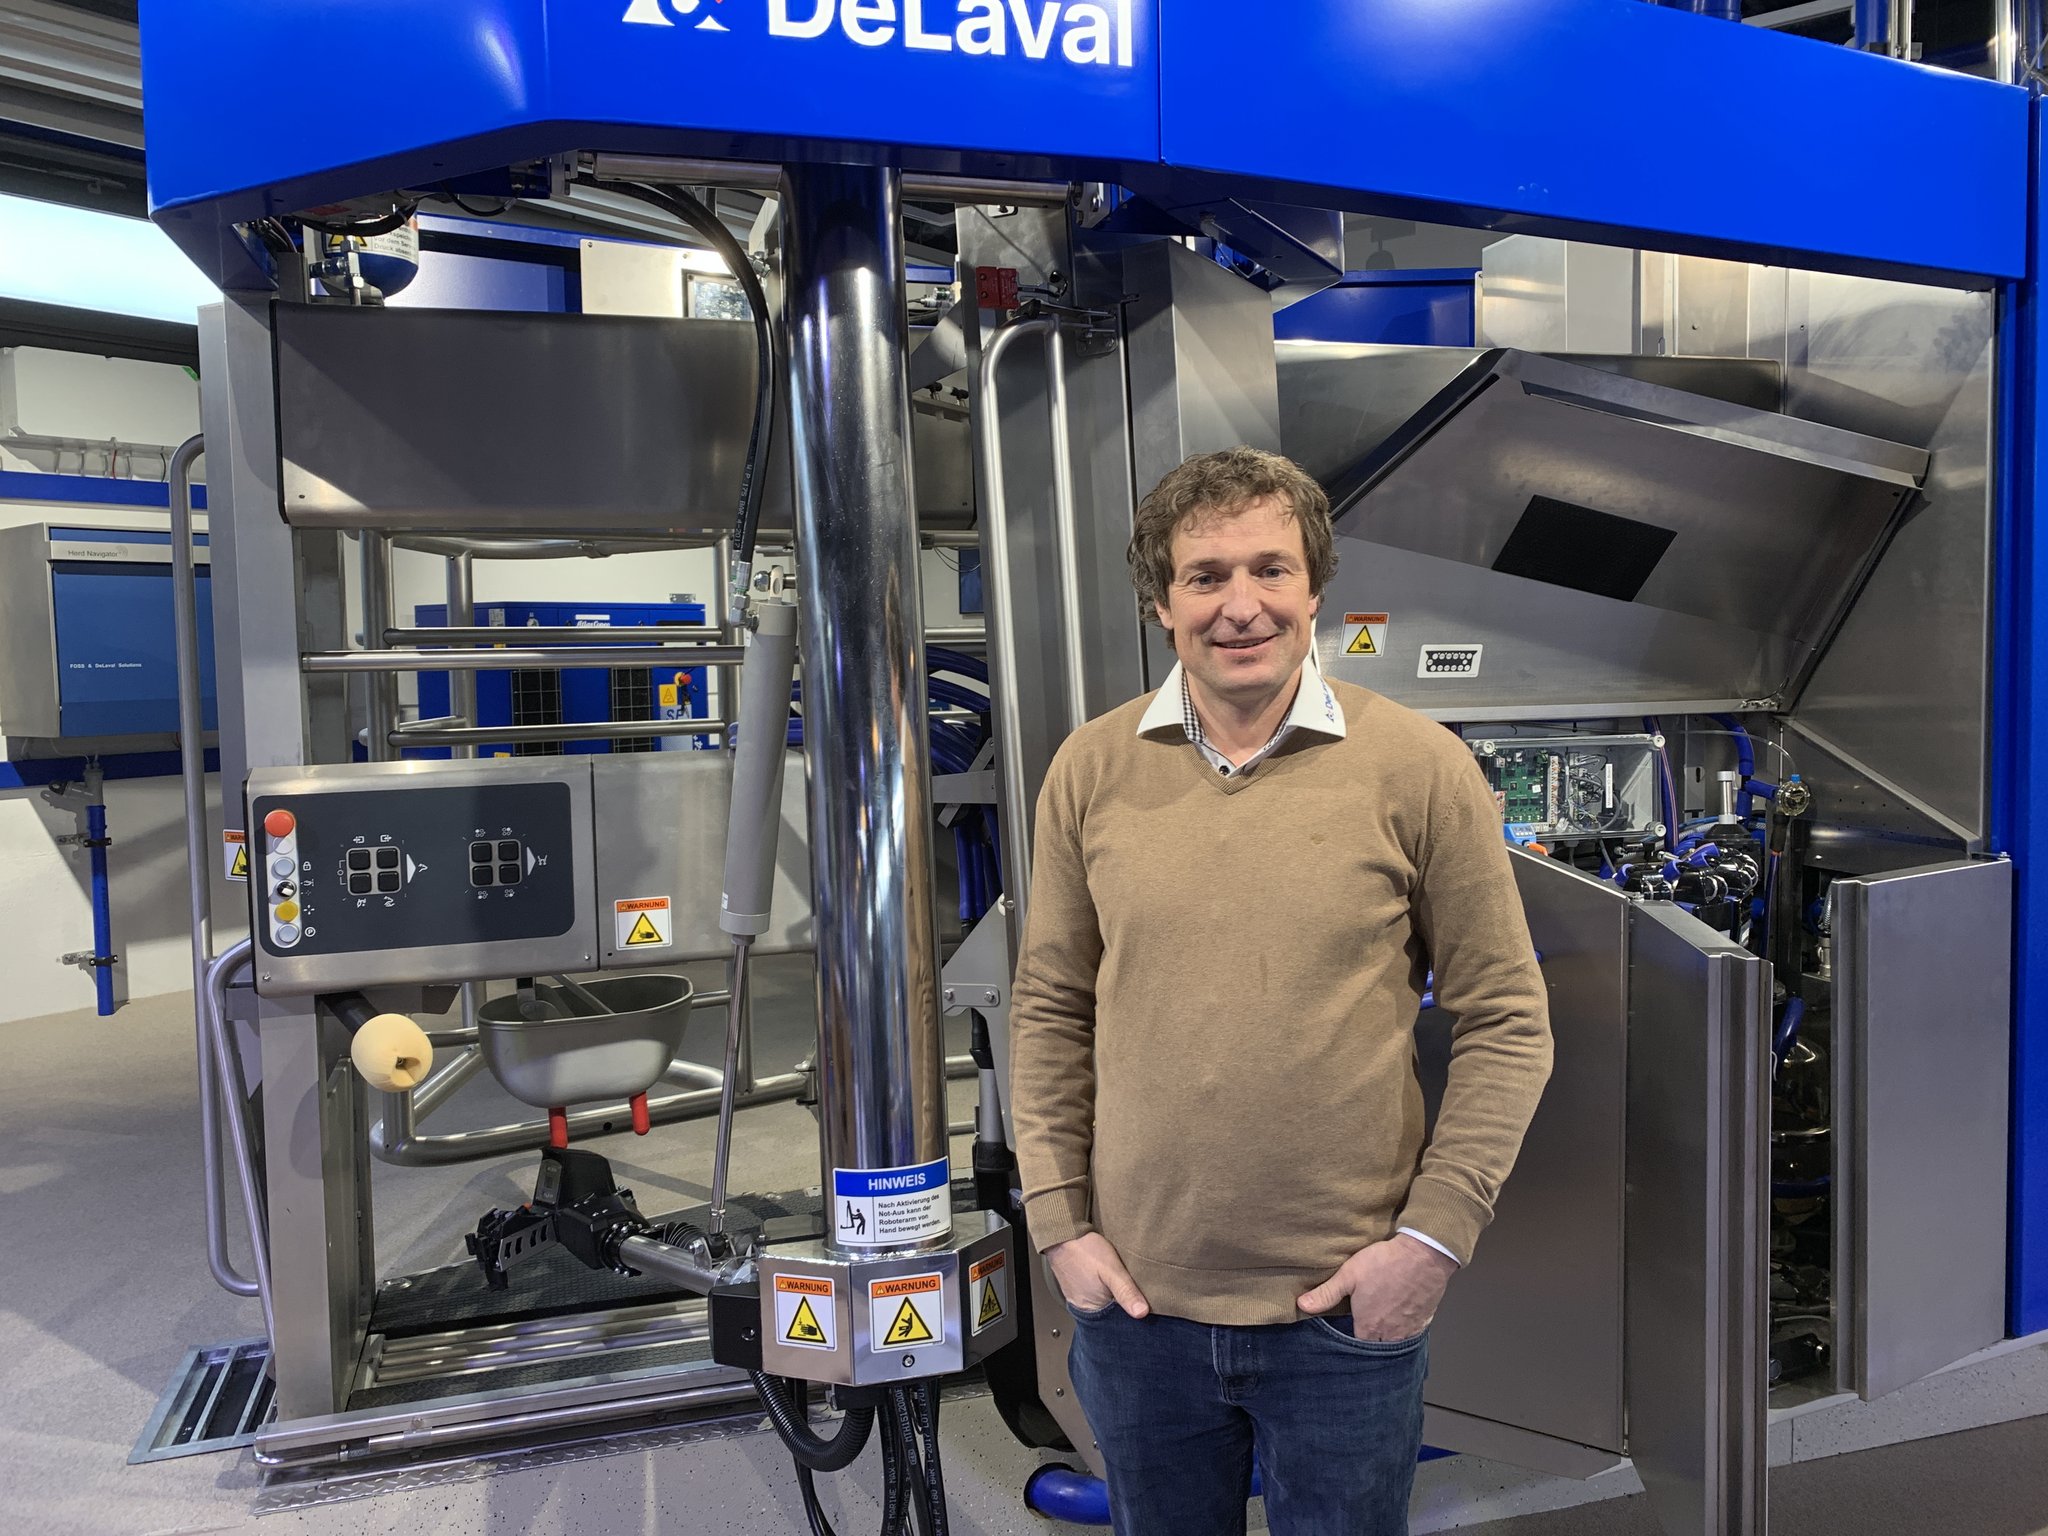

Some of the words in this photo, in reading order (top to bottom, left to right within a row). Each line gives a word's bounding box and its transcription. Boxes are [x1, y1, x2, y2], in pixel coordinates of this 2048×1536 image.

[768, 0, 1133, 67] DeLaval
[737, 500, 746, 516] BAR
[68, 549, 86, 557] Herd
[86, 550, 118, 558] Navigator
[1353, 615, 1385, 623] WARNUNG
[627, 899, 666, 910] WARNUNG
[868, 1172, 926, 1191] HINWEIS
[896, 1196, 931, 1207] Aktivierung
[931, 1193, 940, 1201] des
[906, 1207, 921, 1215] kann
[922, 1204, 932, 1212] der
[879, 1216, 917, 1225] Roboterarm
[879, 1225, 897, 1234] Hand
[898, 1223, 921, 1233] bewegt
[978, 1256, 1004, 1276] WARNUNG
[786, 1280, 829, 1293] WARNUNG
[886, 1278, 936, 1294] WARNUNG
[920, 1413, 929, 1428] LOT
[888, 1467, 896, 1484] MAX
[929, 1468, 937, 1485] BAR
[888, 1488, 897, 1519] MARINE
[930, 1490, 940, 1504] 180
